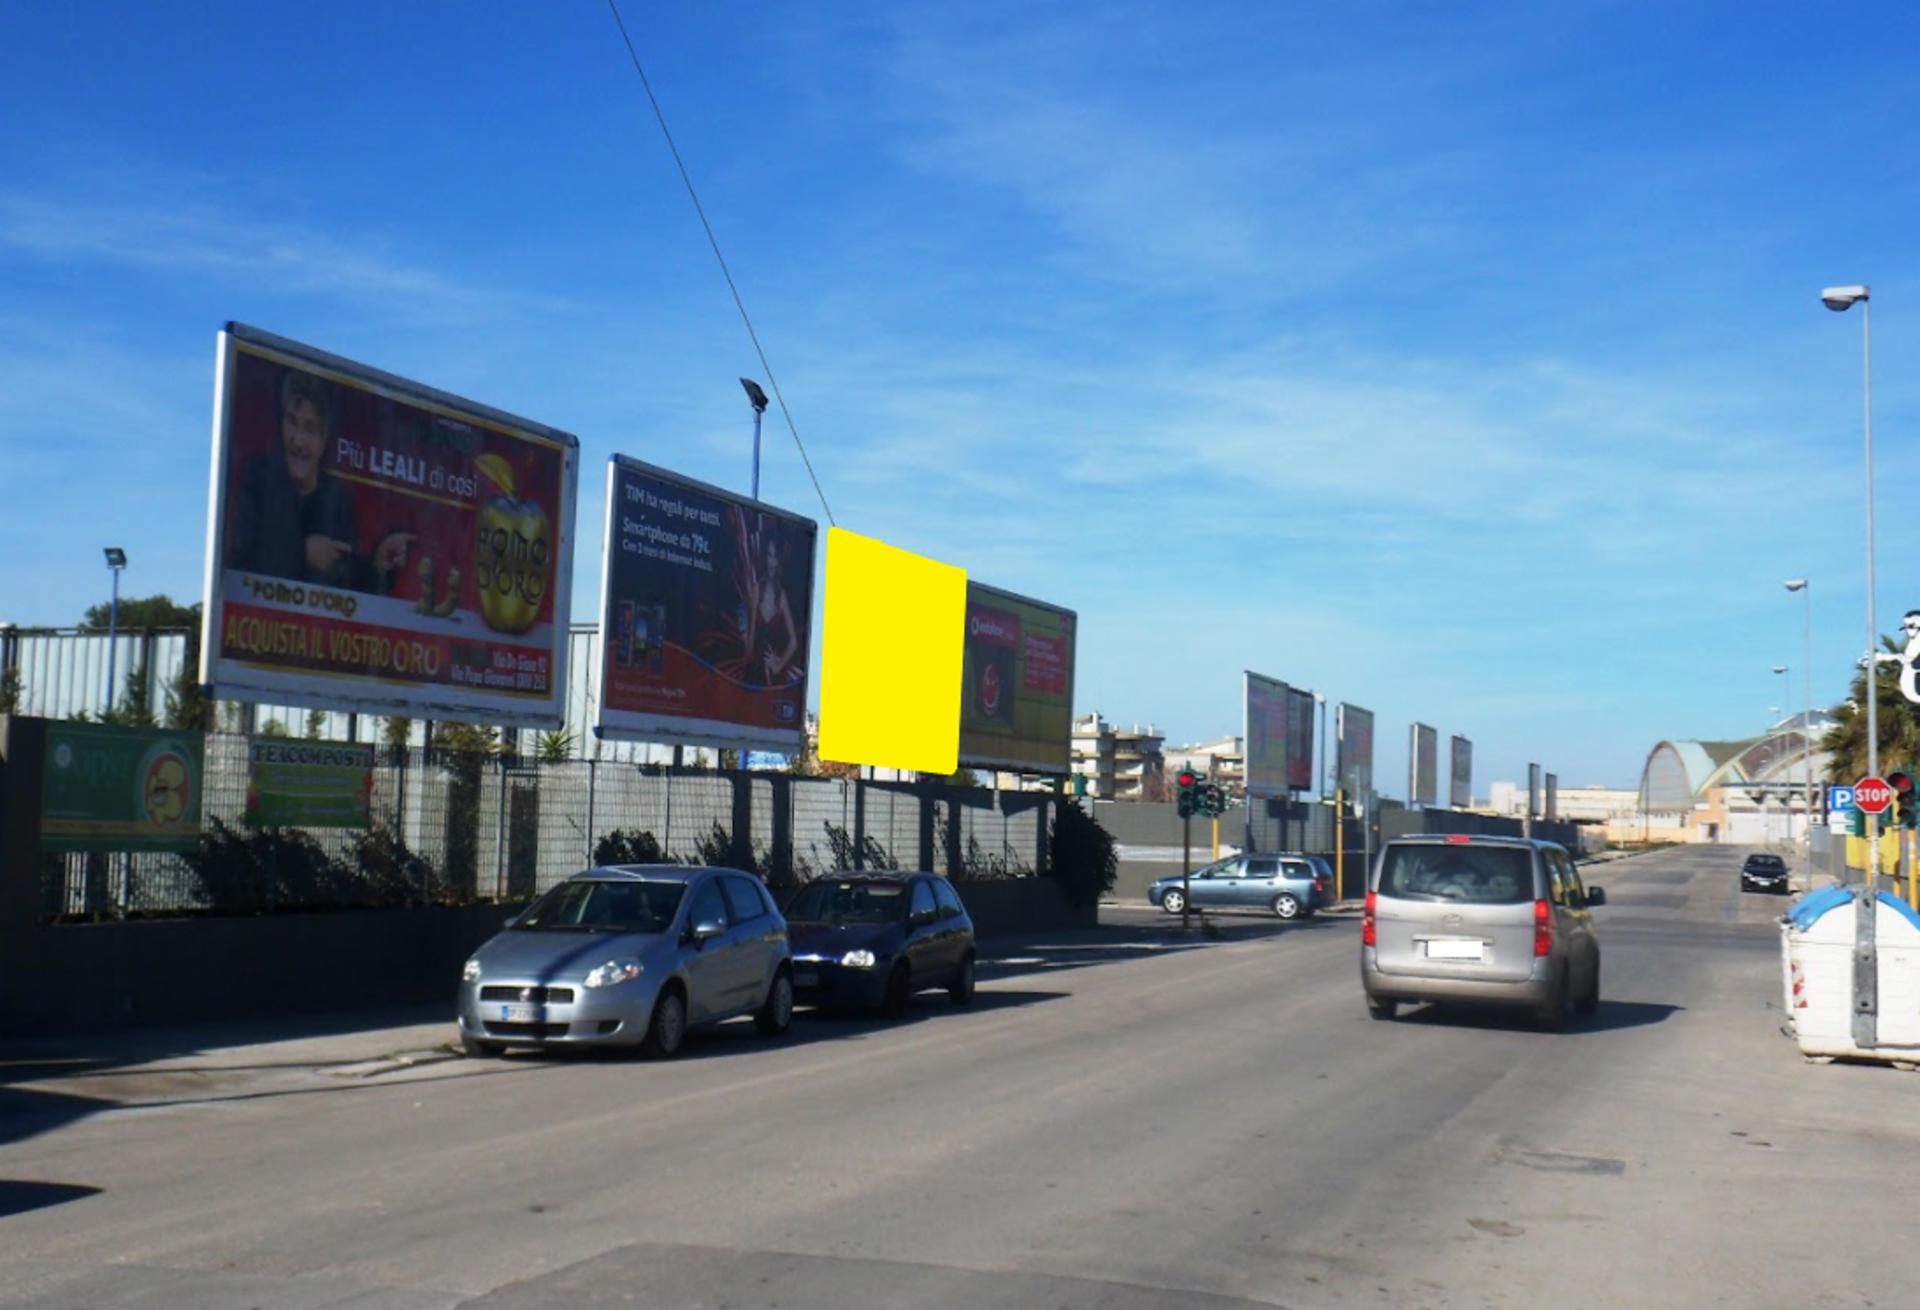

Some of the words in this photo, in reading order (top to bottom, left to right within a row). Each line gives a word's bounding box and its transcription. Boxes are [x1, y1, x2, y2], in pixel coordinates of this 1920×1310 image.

[337, 438, 364, 468] Più
[369, 446, 425, 485] LEALI
[429, 465, 443, 490] di
[624, 484, 645, 505] TIM
[645, 491, 658, 508] ha
[659, 498, 683, 517] regali
[684, 506, 699, 521] per
[479, 527, 550, 566] POMO
[623, 517, 679, 546] Smartphone
[253, 580, 305, 606] POMO
[309, 589, 358, 618] D'ORO
[478, 560, 544, 606] D'ORO
[225, 615, 309, 658] ACQUISTA
[311, 628, 325, 659] IL
[329, 629, 391, 668] VOSTRO
[392, 639, 441, 677] ORO
[1835, 789, 1851, 809] P
[1855, 788, 1890, 803] STOP
